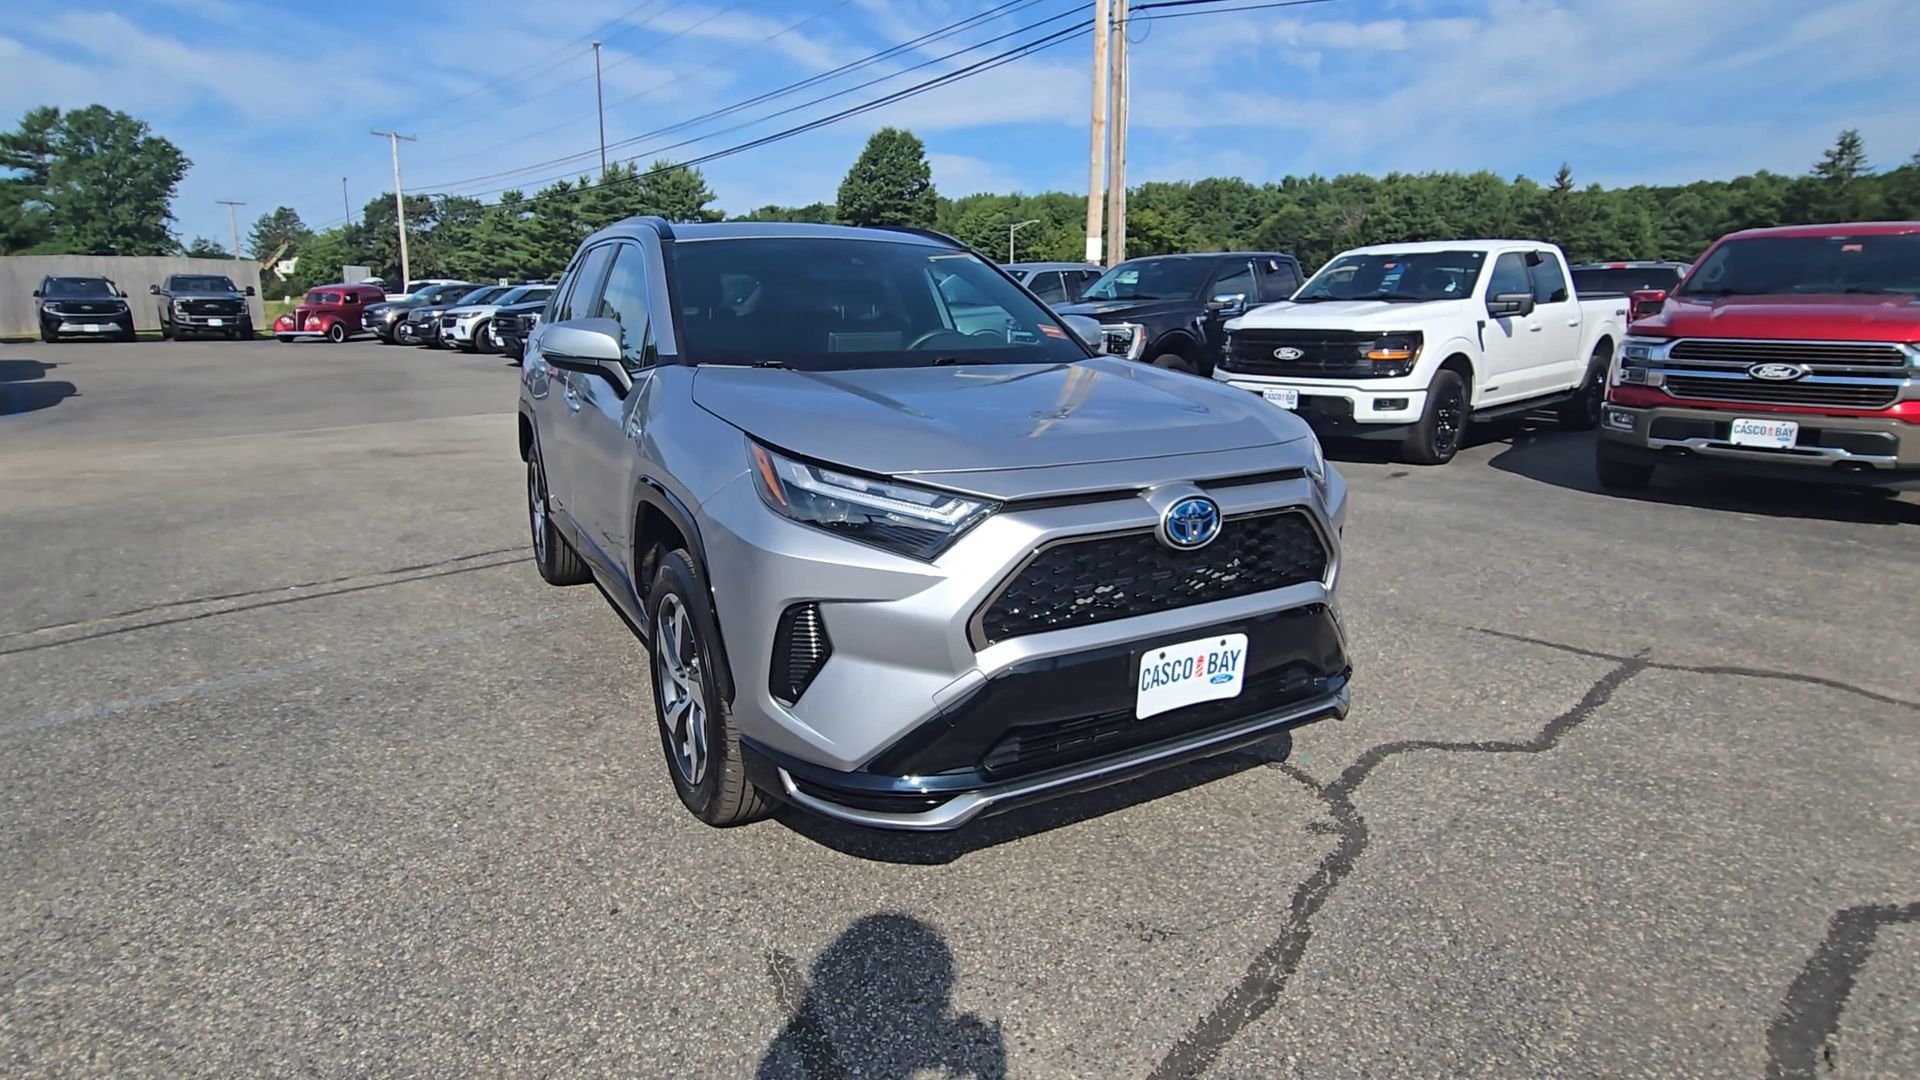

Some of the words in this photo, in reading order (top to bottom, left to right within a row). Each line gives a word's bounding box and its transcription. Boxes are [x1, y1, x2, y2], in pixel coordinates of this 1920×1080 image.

[1758, 365, 1792, 378] Ford
[1734, 424, 1767, 436] CASCO
[1775, 427, 1795, 437] BAY
[1141, 657, 1194, 691] CASCO
[1207, 650, 1241, 675] BAY
